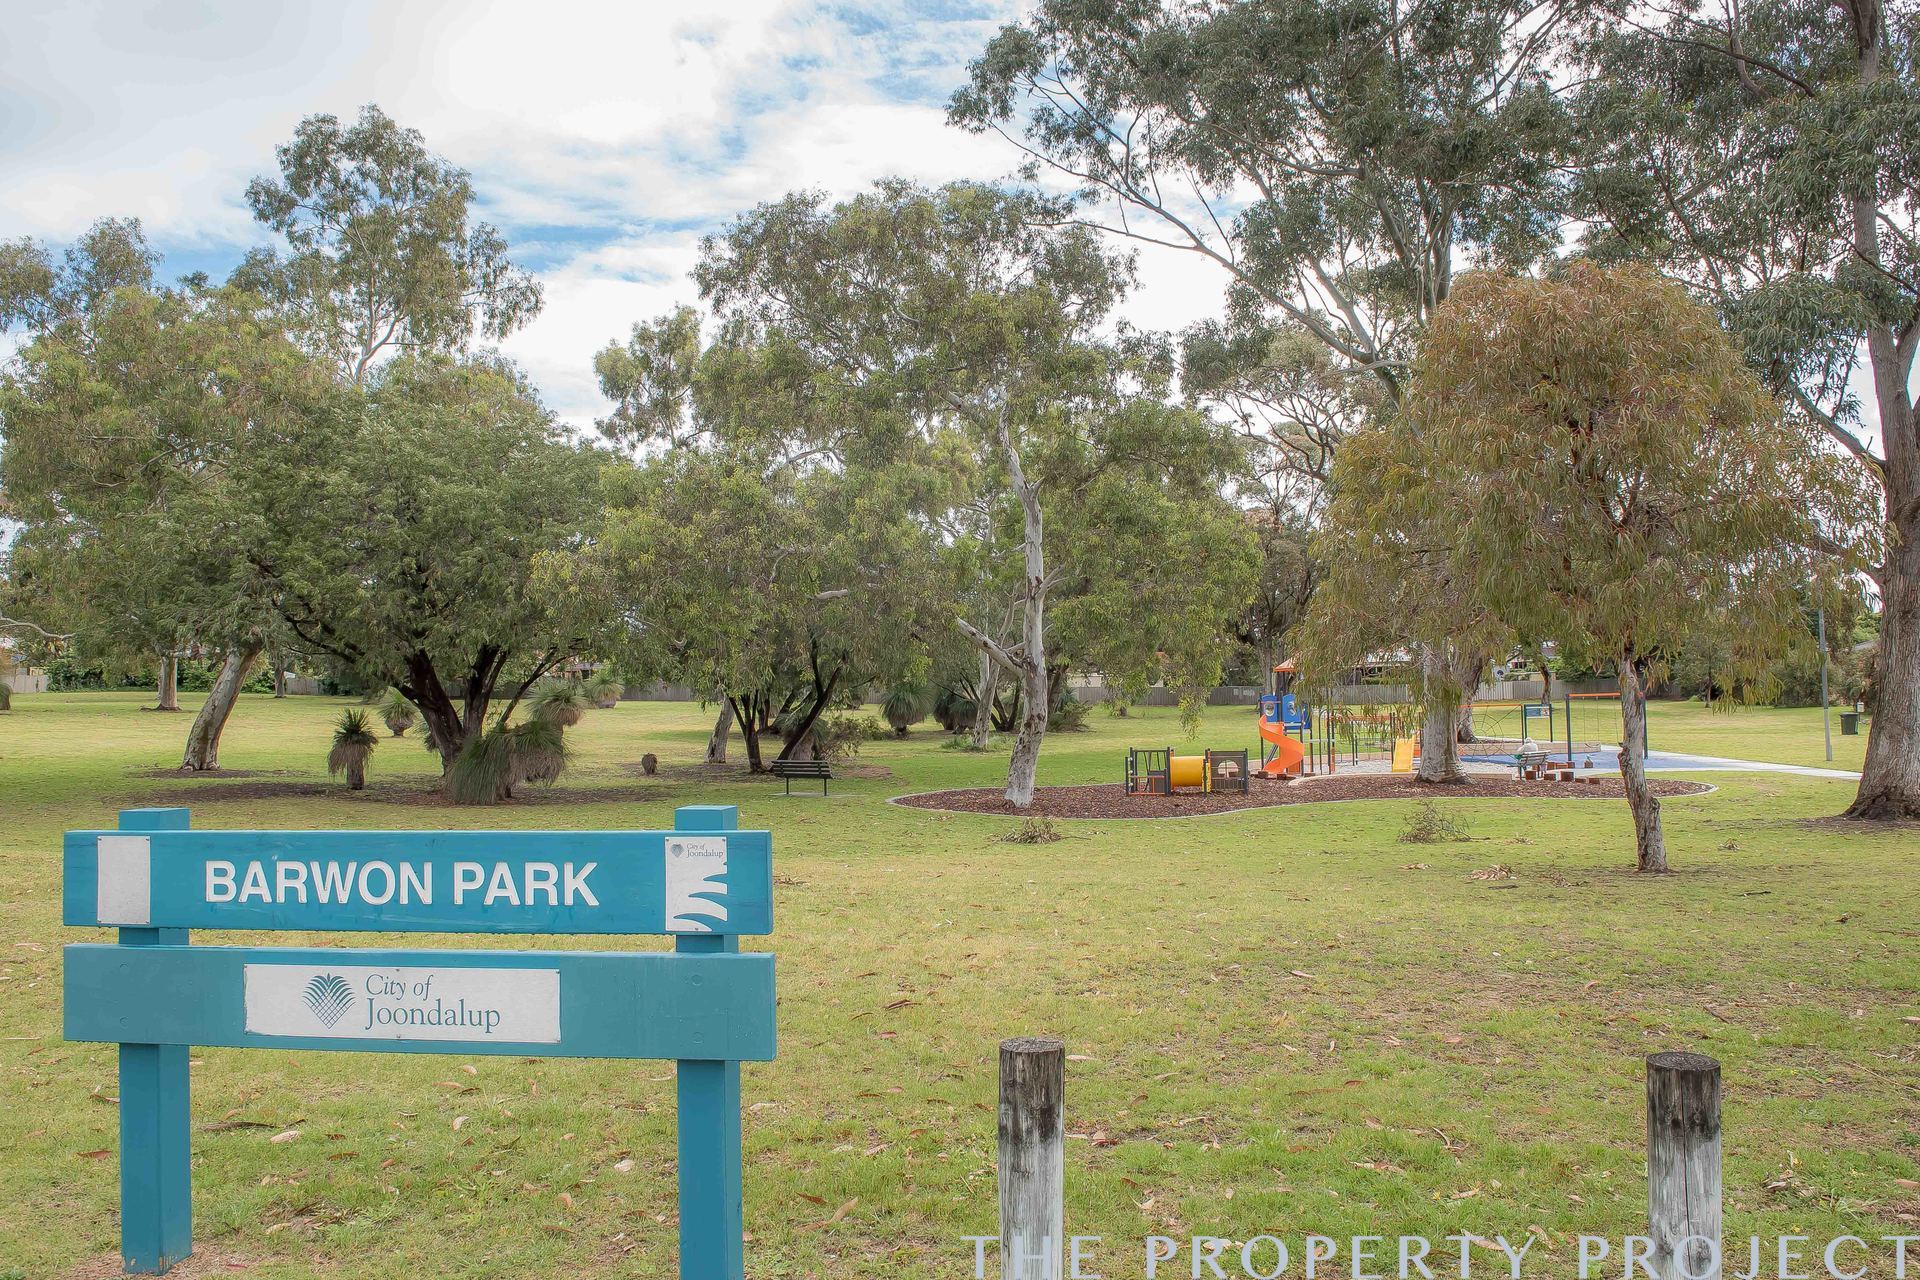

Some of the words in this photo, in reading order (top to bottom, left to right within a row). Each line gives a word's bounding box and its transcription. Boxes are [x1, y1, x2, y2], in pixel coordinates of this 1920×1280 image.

[686, 849, 724, 858] Joondalup
[204, 859, 434, 905] BARWON
[452, 861, 601, 907] PARK
[365, 974, 406, 1001] City
[413, 974, 434, 1001] of
[365, 997, 501, 1033] Joondalup
